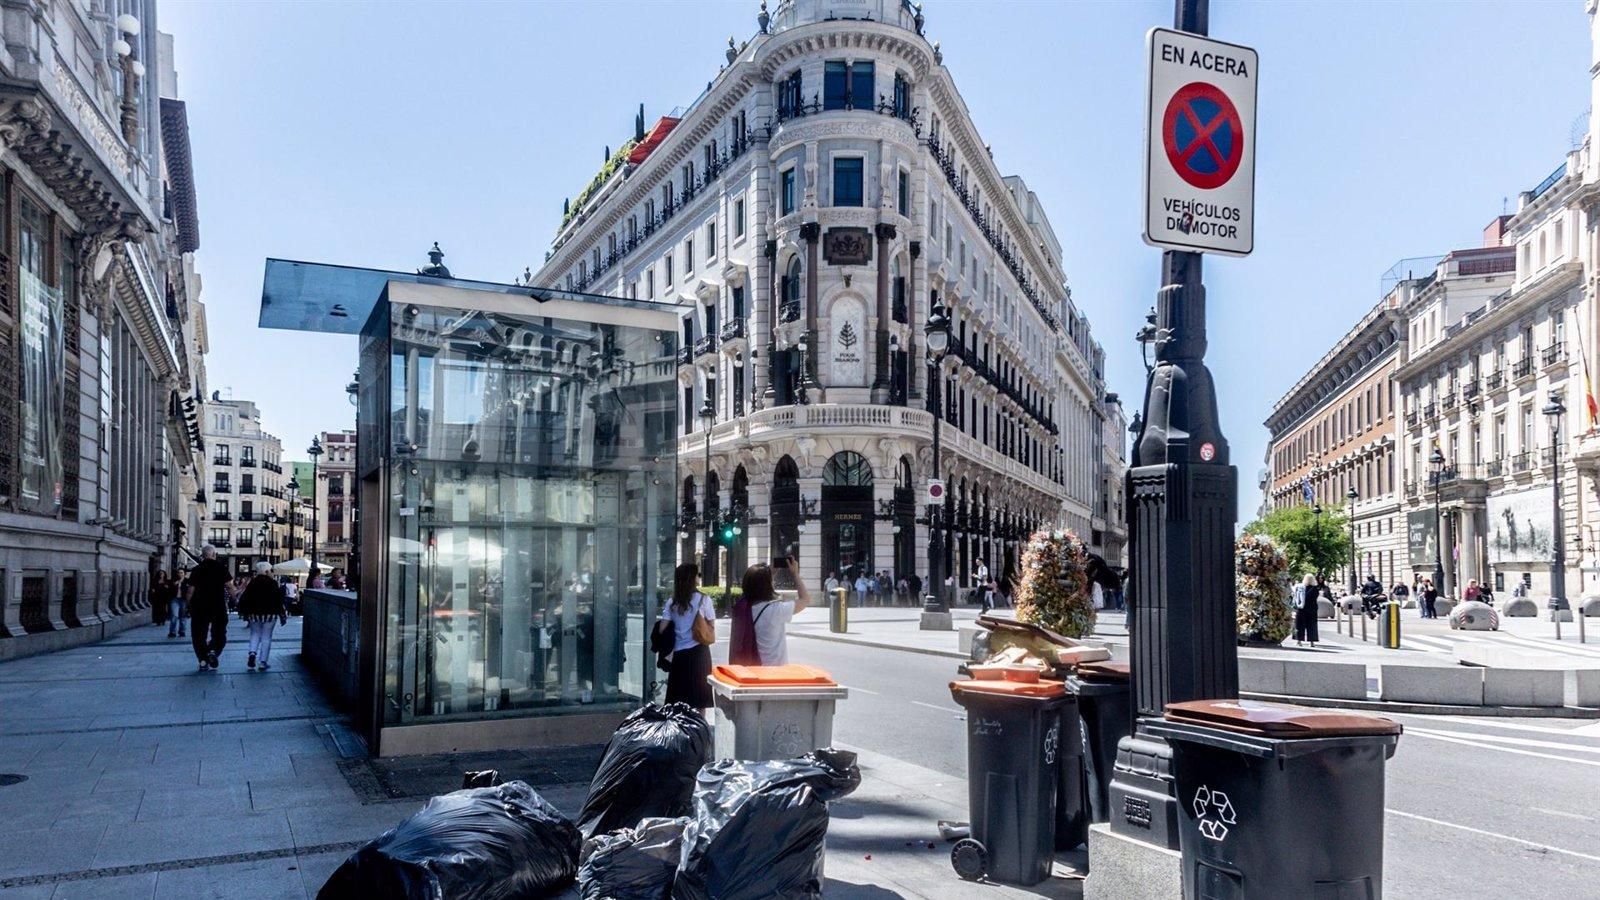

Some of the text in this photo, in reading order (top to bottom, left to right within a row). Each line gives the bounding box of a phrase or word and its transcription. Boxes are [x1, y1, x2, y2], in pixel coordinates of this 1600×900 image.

[1162, 44, 1248, 78] EN ACERA
[1163, 198, 1240, 221] VEHÍCULOS
[1191, 221, 1237, 239] MOTOR
